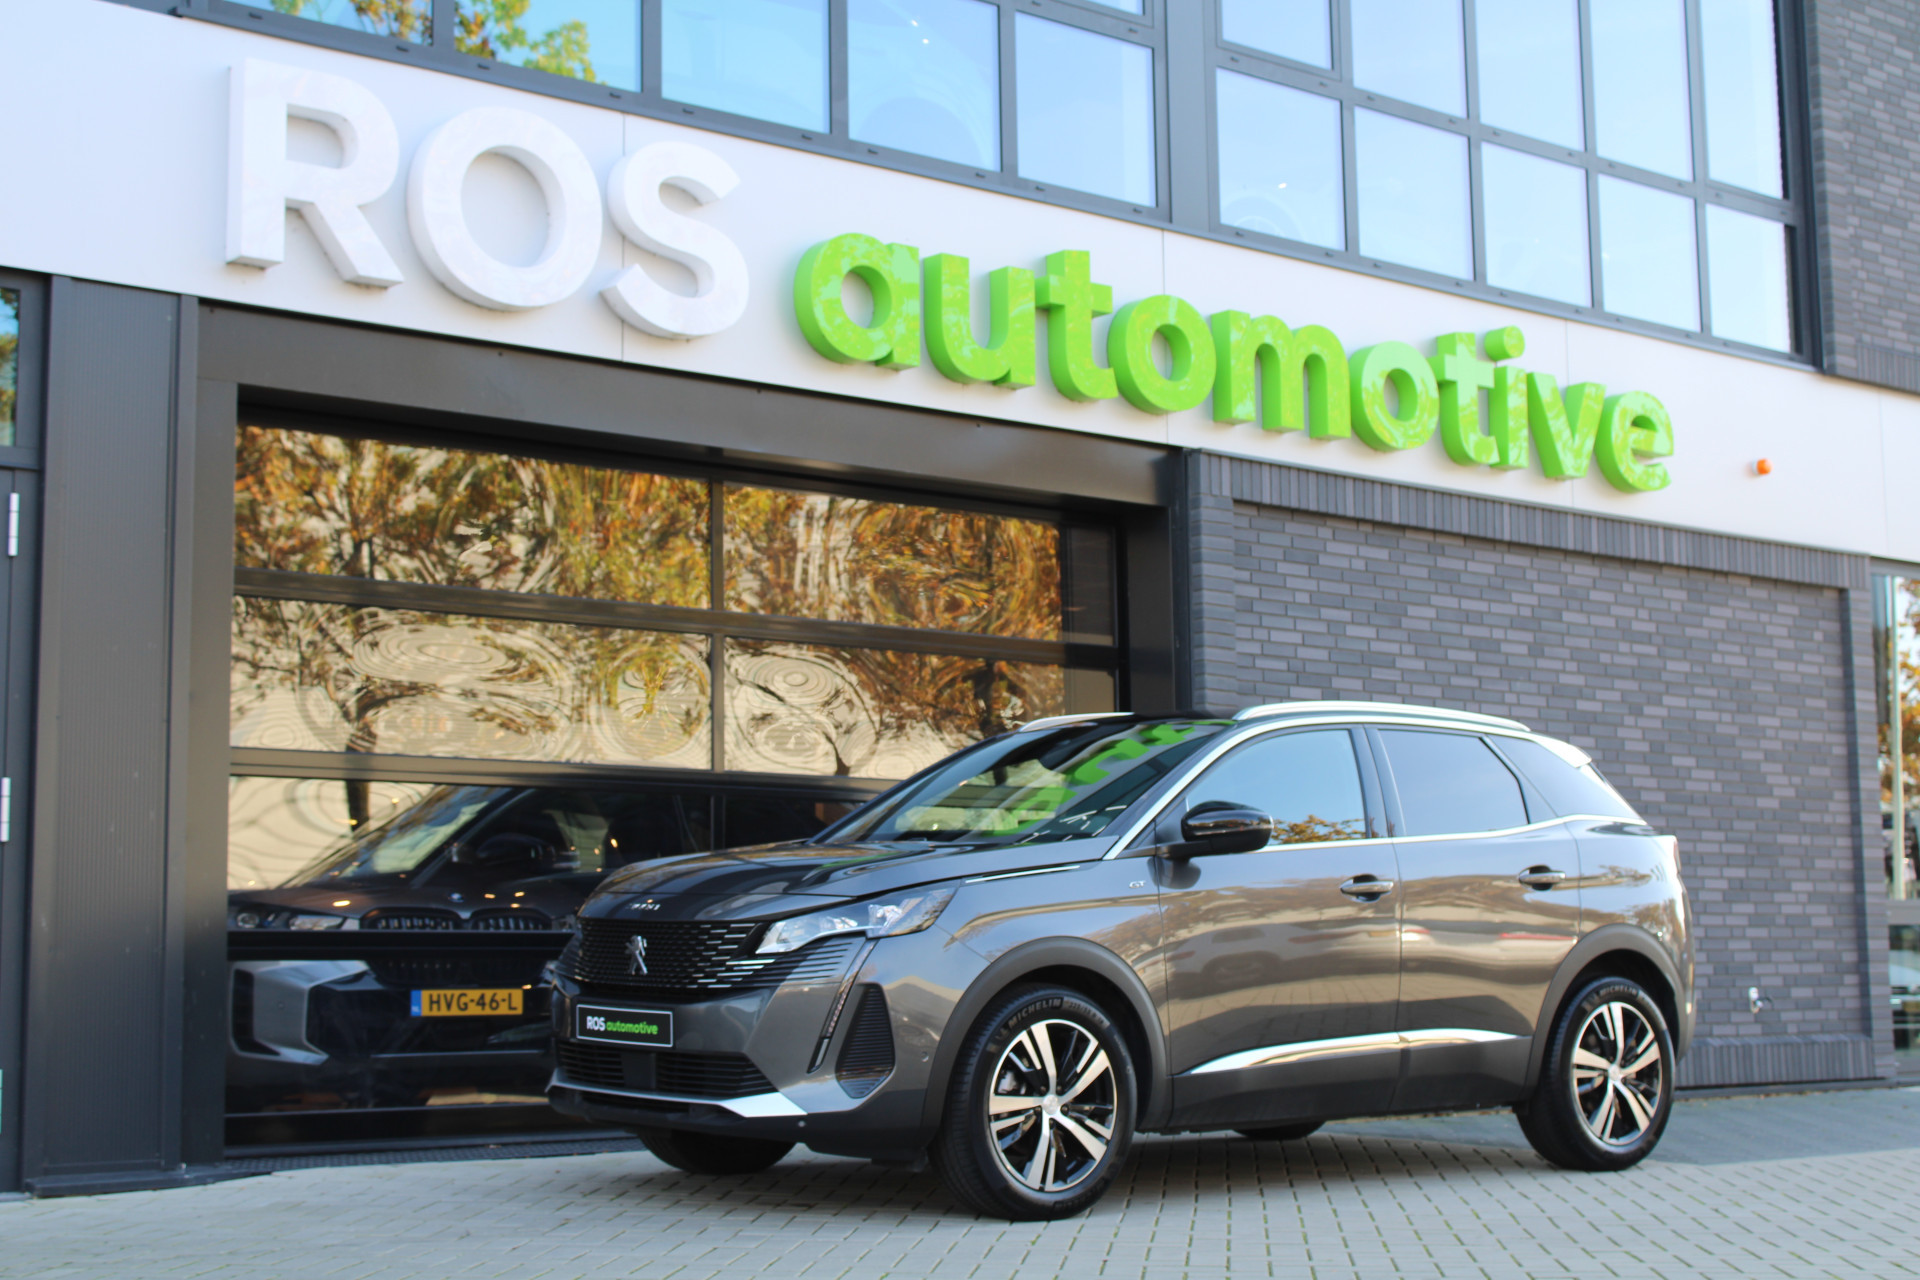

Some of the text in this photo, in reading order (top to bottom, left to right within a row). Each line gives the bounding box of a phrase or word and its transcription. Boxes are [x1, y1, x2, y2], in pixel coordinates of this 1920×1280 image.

[225, 57, 1674, 493] ROS automotive
[1129, 880, 1146, 889] GT
[1599, 985, 1638, 997] MICHELIN
[428, 993, 518, 1012] HVG-46-L
[1008, 998, 1063, 1028] MICHELIN
[586, 1015, 659, 1035] ROS automotive
